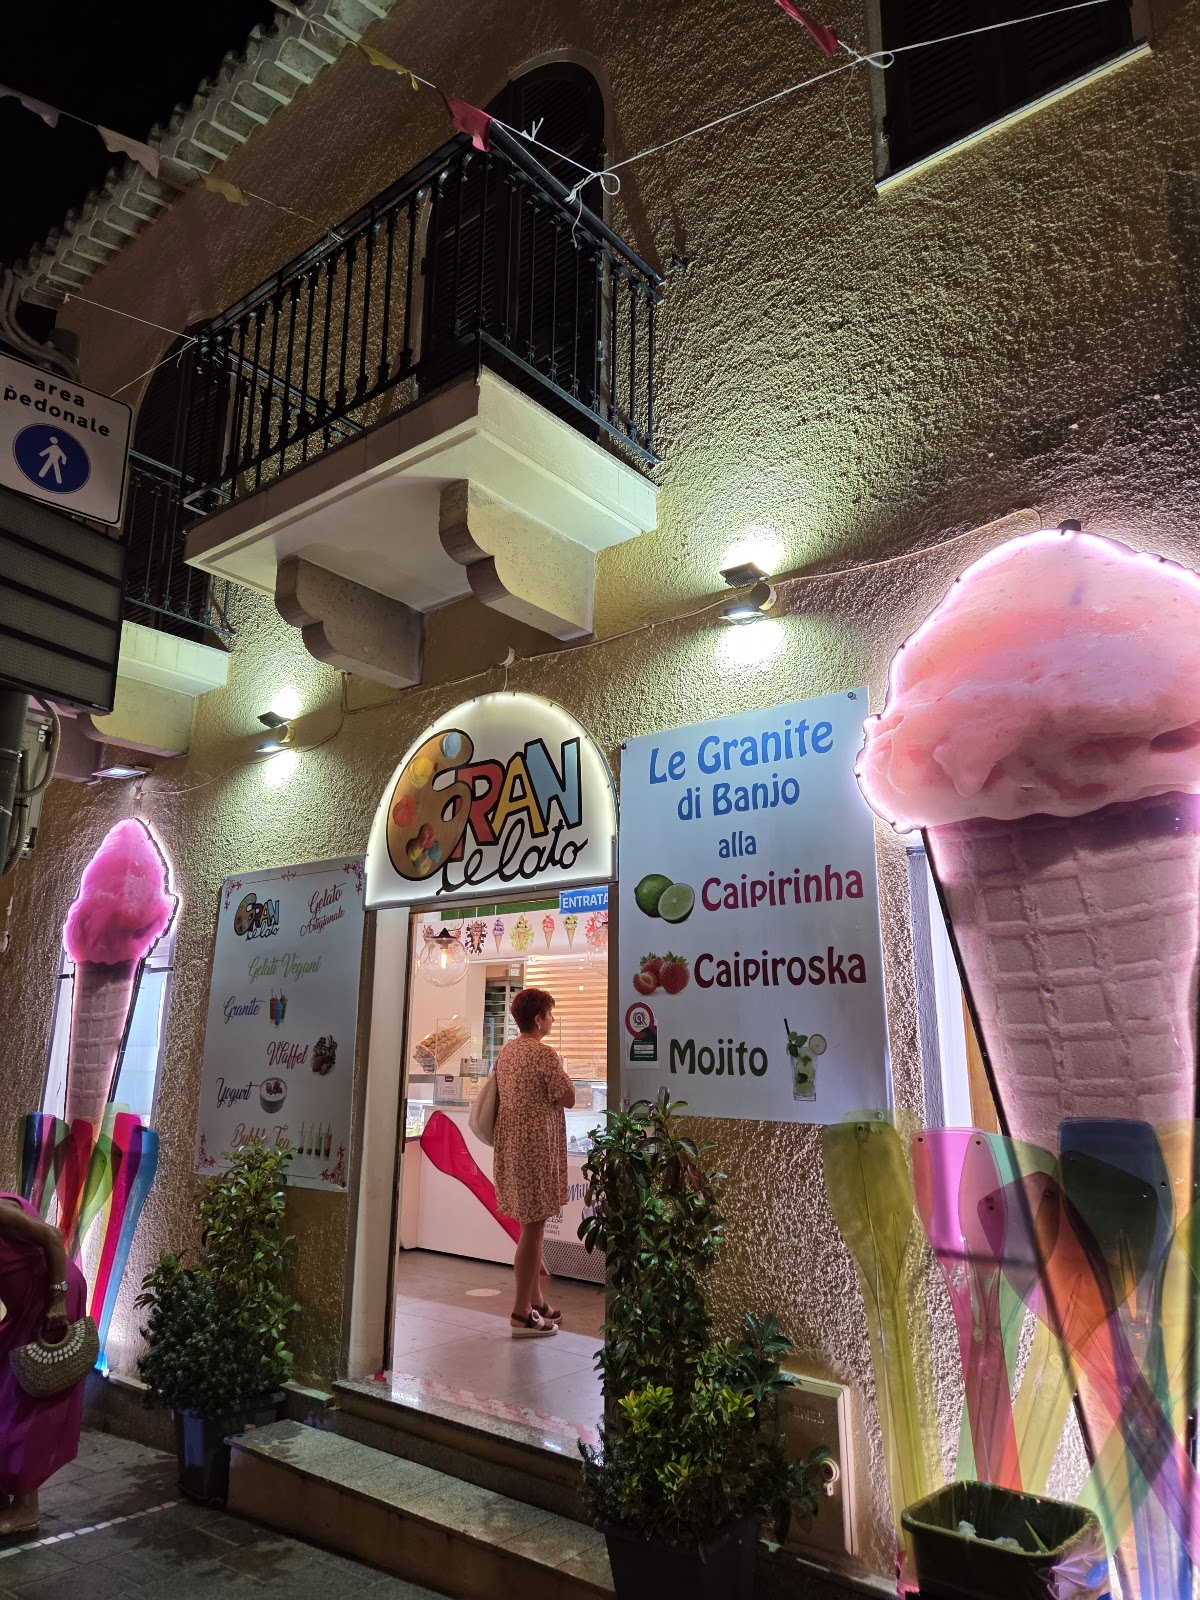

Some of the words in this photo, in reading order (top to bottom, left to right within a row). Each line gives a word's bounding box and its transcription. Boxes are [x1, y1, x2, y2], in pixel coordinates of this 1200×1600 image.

[34, 379, 85, 407] area
[4, 387, 109, 436] pedonale
[650, 748, 686, 784] Le
[698, 719, 833, 774] Granite
[678, 787, 701, 820] di
[712, 773, 800, 816] Banjo
[719, 831, 757, 858] alla
[308, 883, 347, 919] Gelato
[562, 893, 608, 909] ENTRATA
[701, 864, 864, 911] Caipirinha
[300, 905, 345, 937] Artigianale
[248, 956, 283, 984] Gelati
[281, 952, 321, 983] Vegani
[694, 946, 867, 988] Caipiroska
[223, 996, 265, 1024] Granite
[267, 1041, 309, 1069] Waffel
[670, 1039, 768, 1076] Mojito
[216, 1077, 260, 1108] Yogurt
[273, 1125, 293, 1149] Tea
